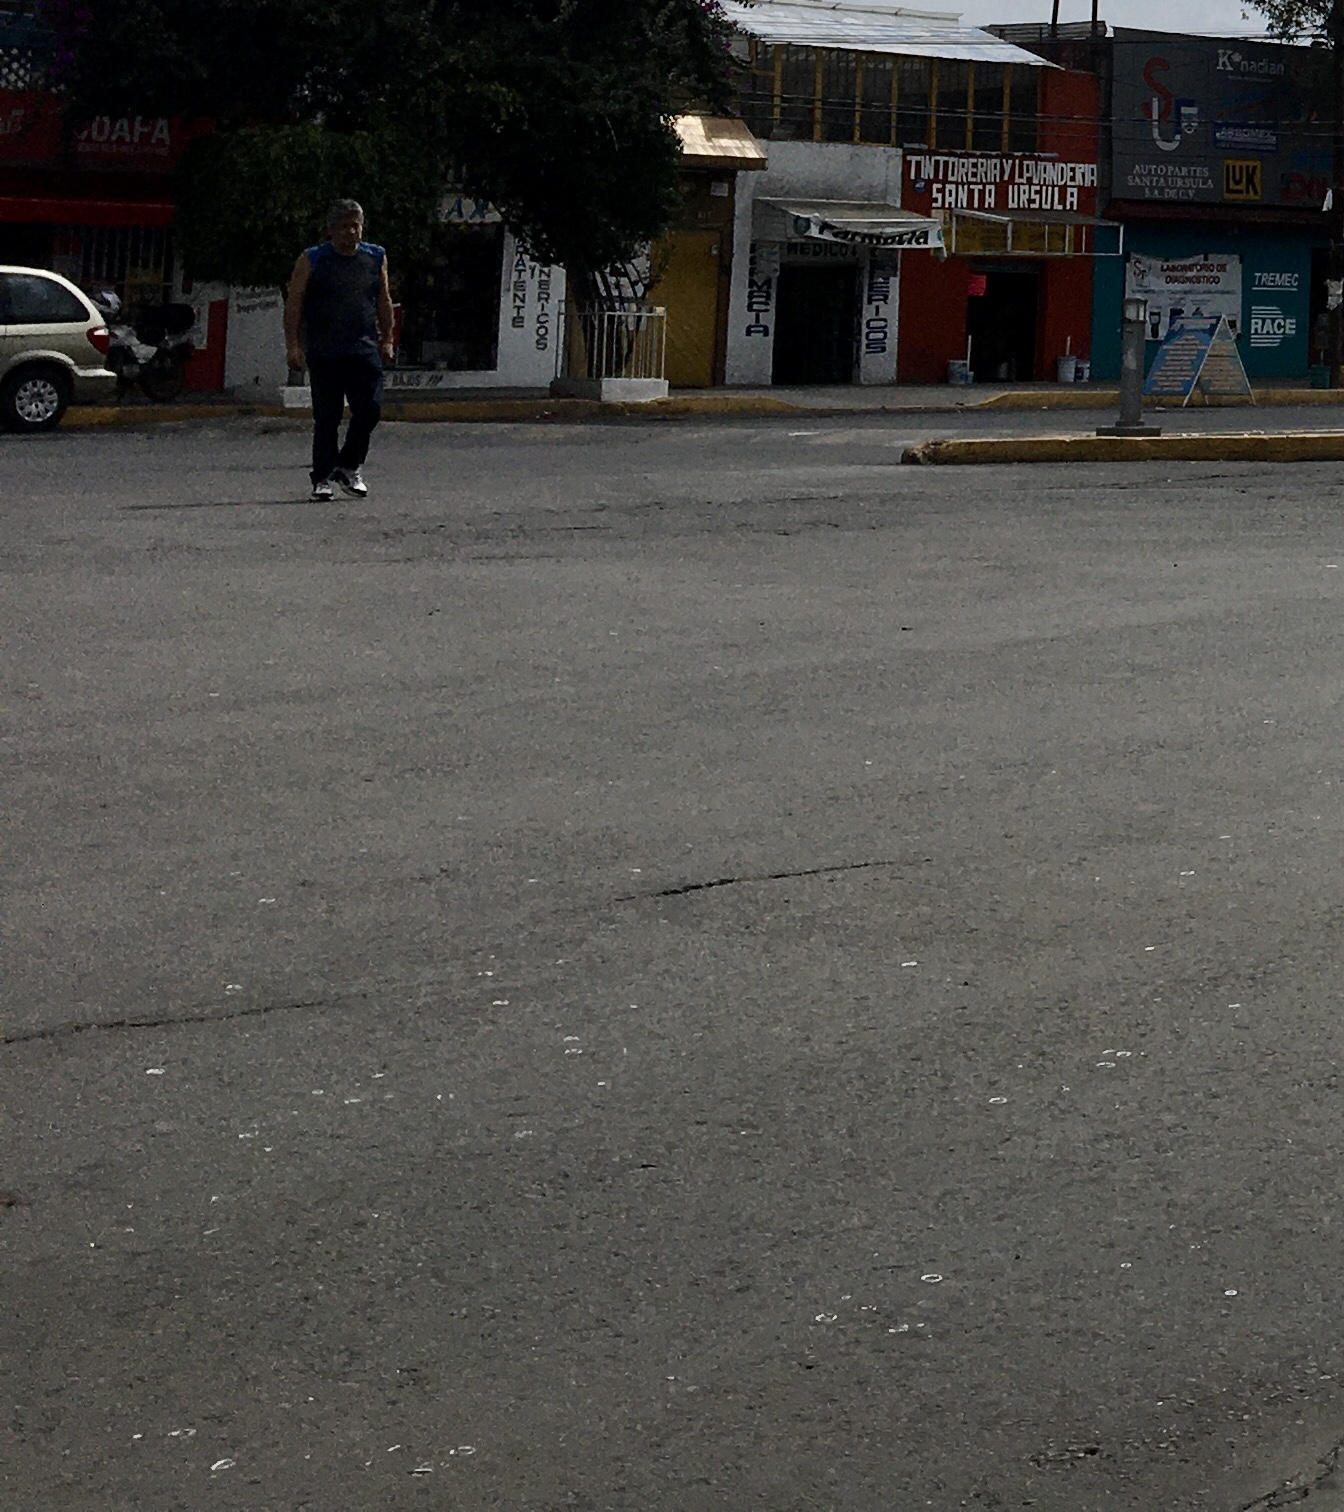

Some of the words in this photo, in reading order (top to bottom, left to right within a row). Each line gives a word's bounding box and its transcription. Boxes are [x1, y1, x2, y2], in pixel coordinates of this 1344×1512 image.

[906, 155, 1000, 184] TINTORERIA
[1002, 159, 1015, 181] Y
[1127, 175, 1166, 186] SANTA
[1168, 177, 1214, 188] URSULA
[932, 183, 996, 208] SANTA
[1007, 186, 1079, 211] URSULA
[1254, 273, 1299, 286] TREMEC
[536, 269, 551, 350] NERICOS
[1251, 319, 1297, 336] RACE
